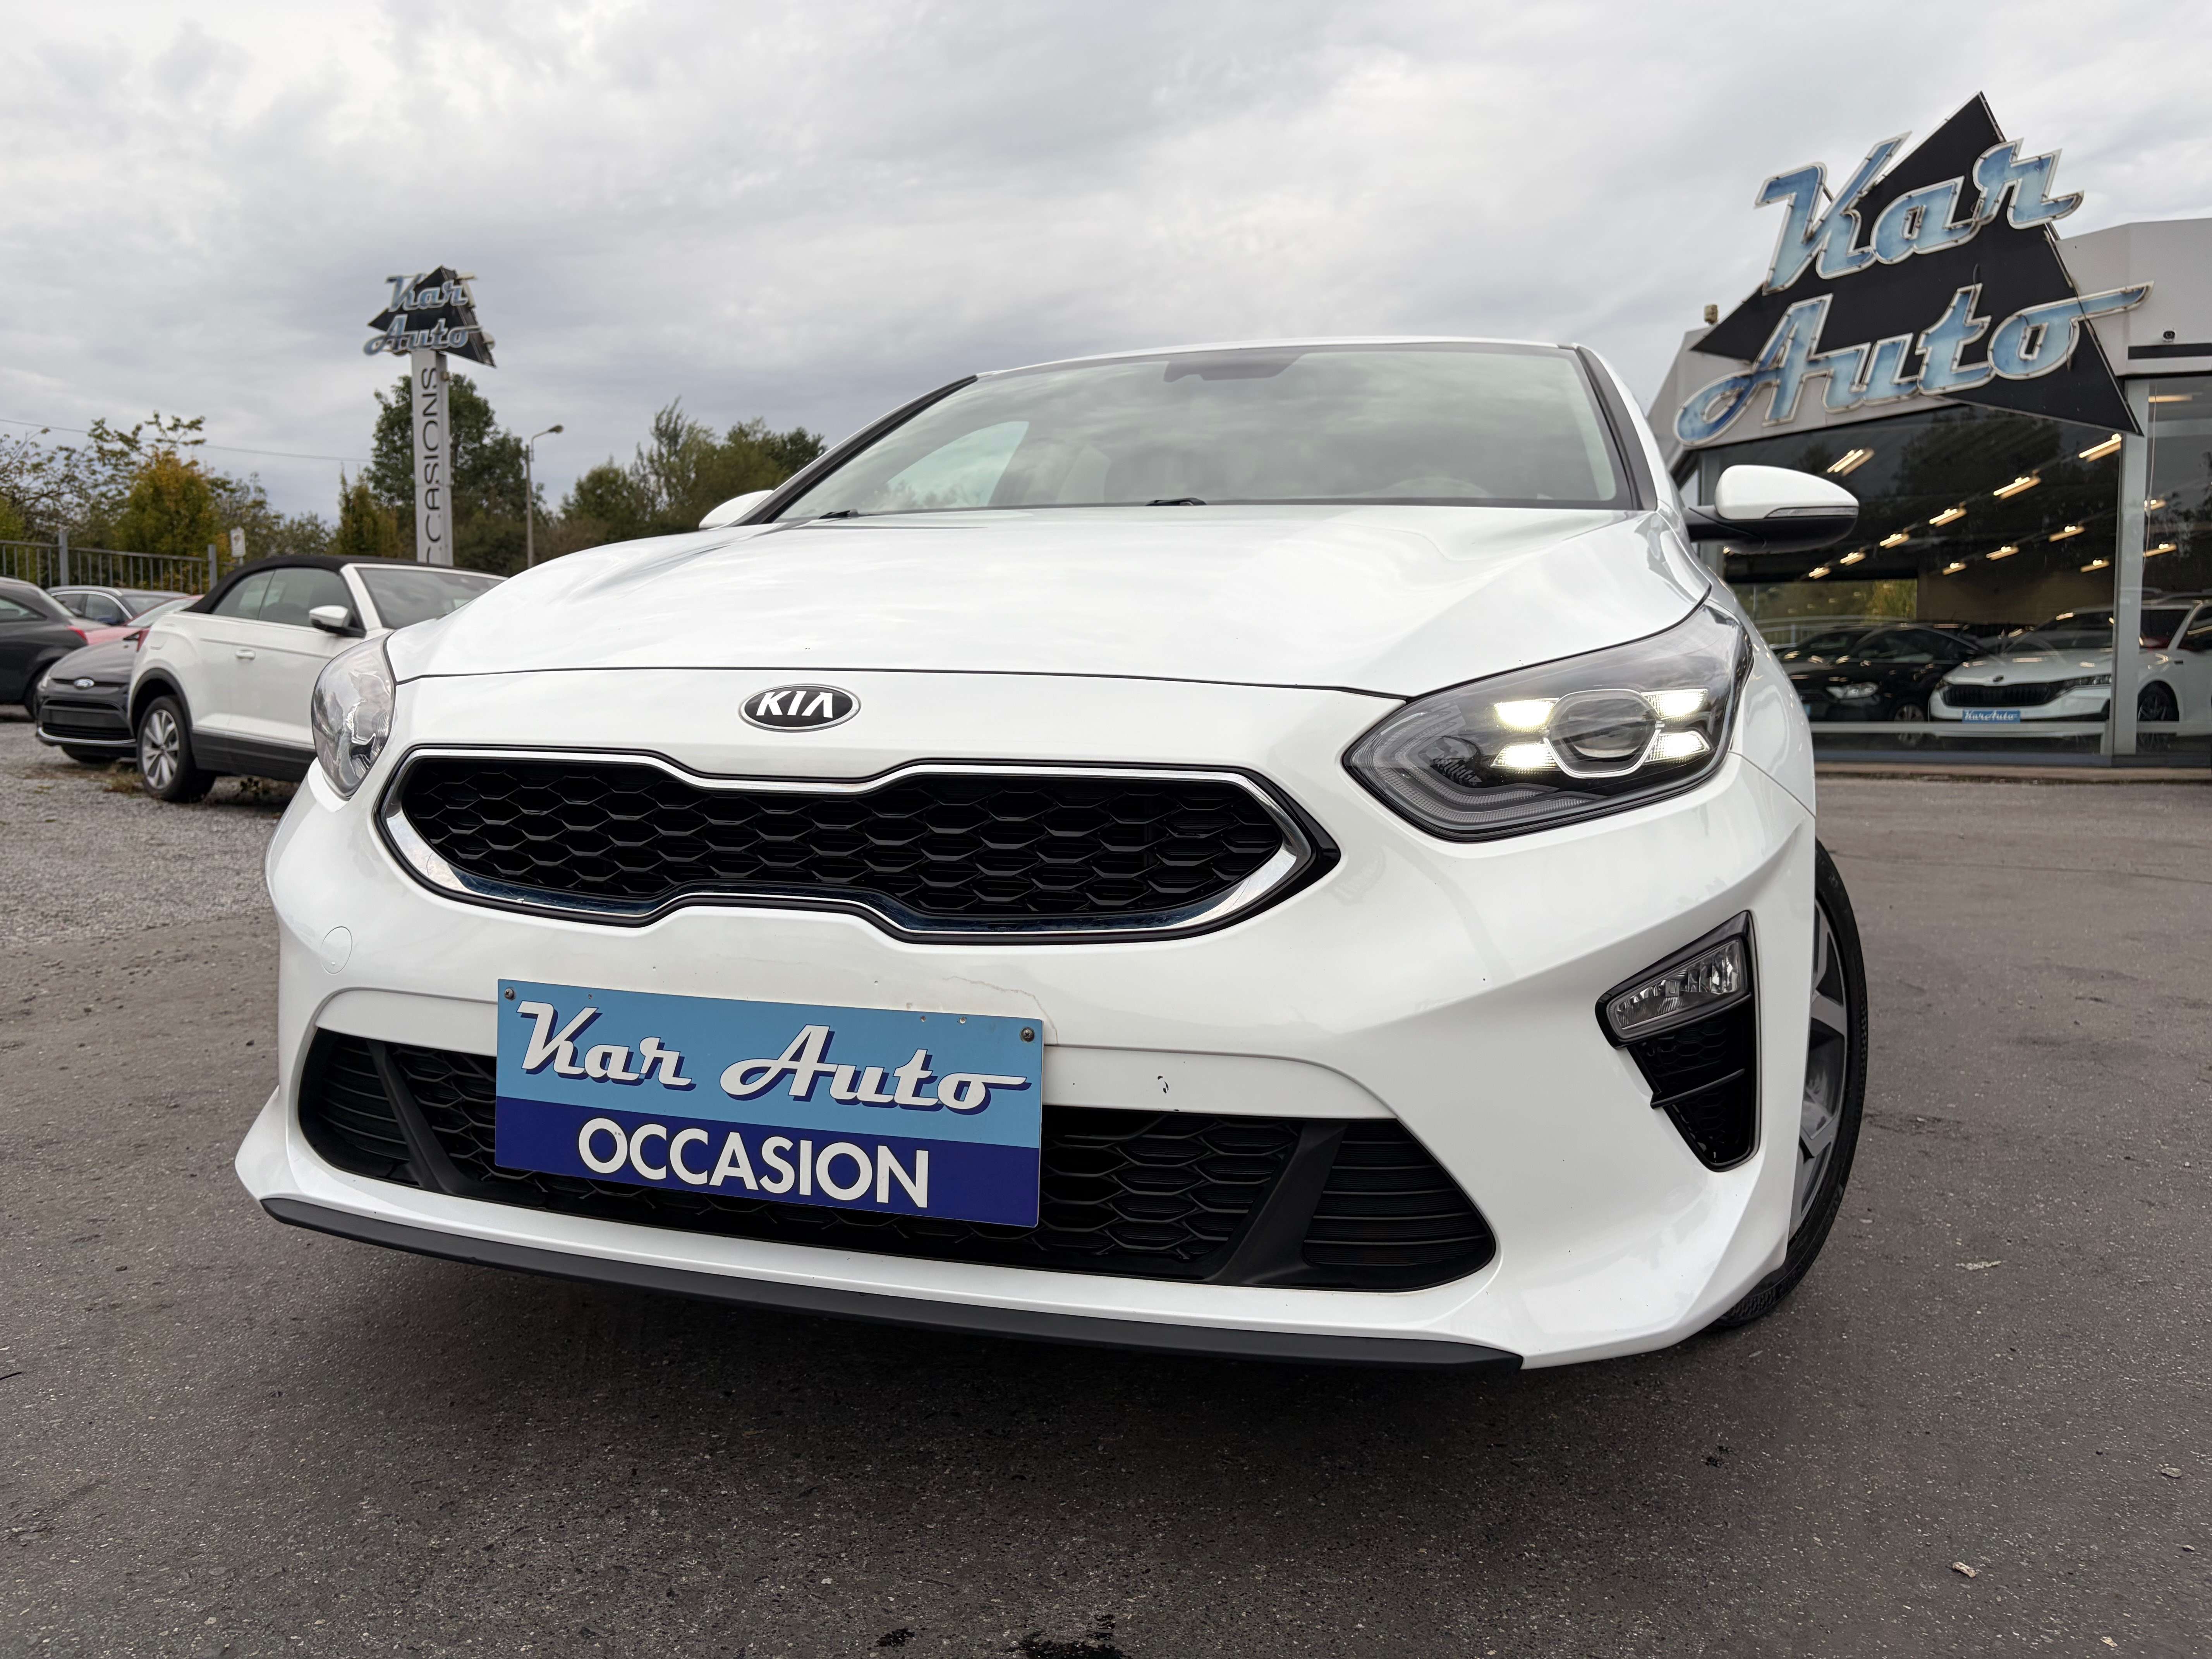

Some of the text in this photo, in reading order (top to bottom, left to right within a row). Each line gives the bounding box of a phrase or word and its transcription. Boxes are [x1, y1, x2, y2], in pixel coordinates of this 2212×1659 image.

[1755, 131, 2084, 295] Kar
[363, 314, 482, 356] Auto
[386, 273, 469, 312] Kar
[1674, 282, 2154, 447] Auto
[756, 691, 833, 718] KIA
[515, 1000, 1031, 1115] Kar Auto
[578, 1118, 928, 1208] OCCASION
